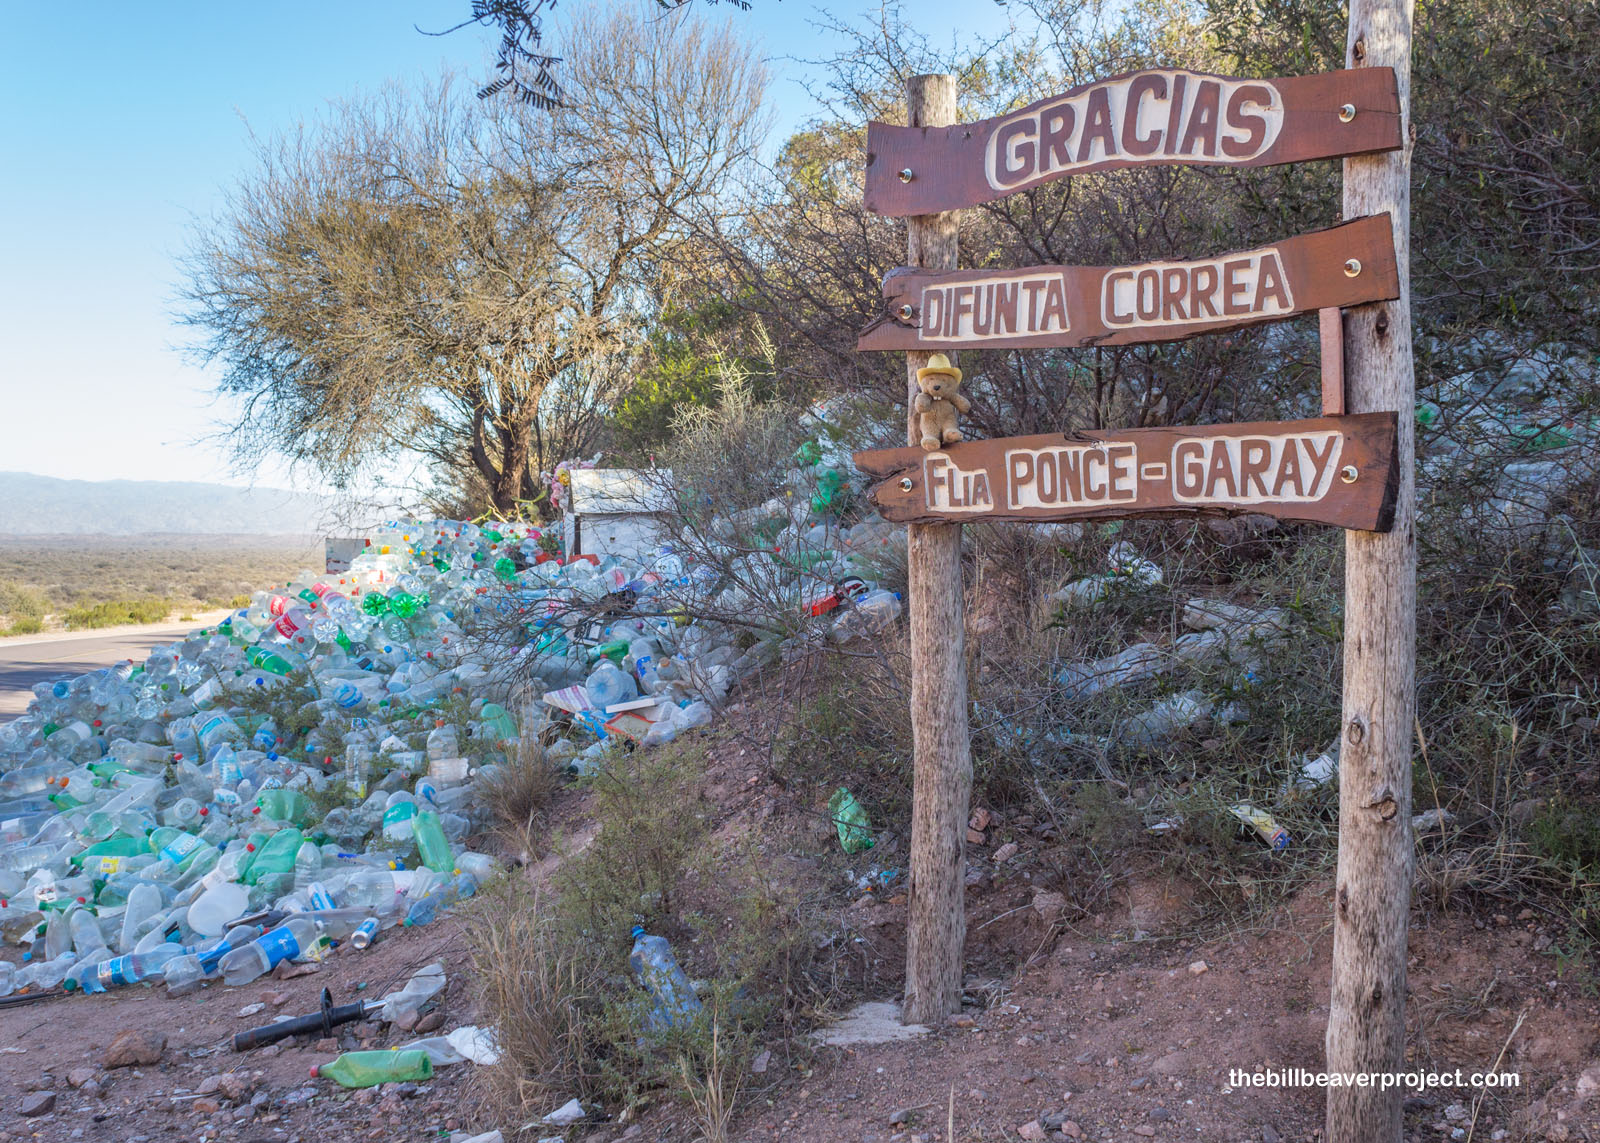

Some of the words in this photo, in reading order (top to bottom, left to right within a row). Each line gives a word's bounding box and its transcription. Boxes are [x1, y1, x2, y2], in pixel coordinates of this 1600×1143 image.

[995, 73, 1273, 187] GRACIAS
[922, 278, 1068, 338] DIFUNTA
[1103, 253, 1291, 325] CORREA
